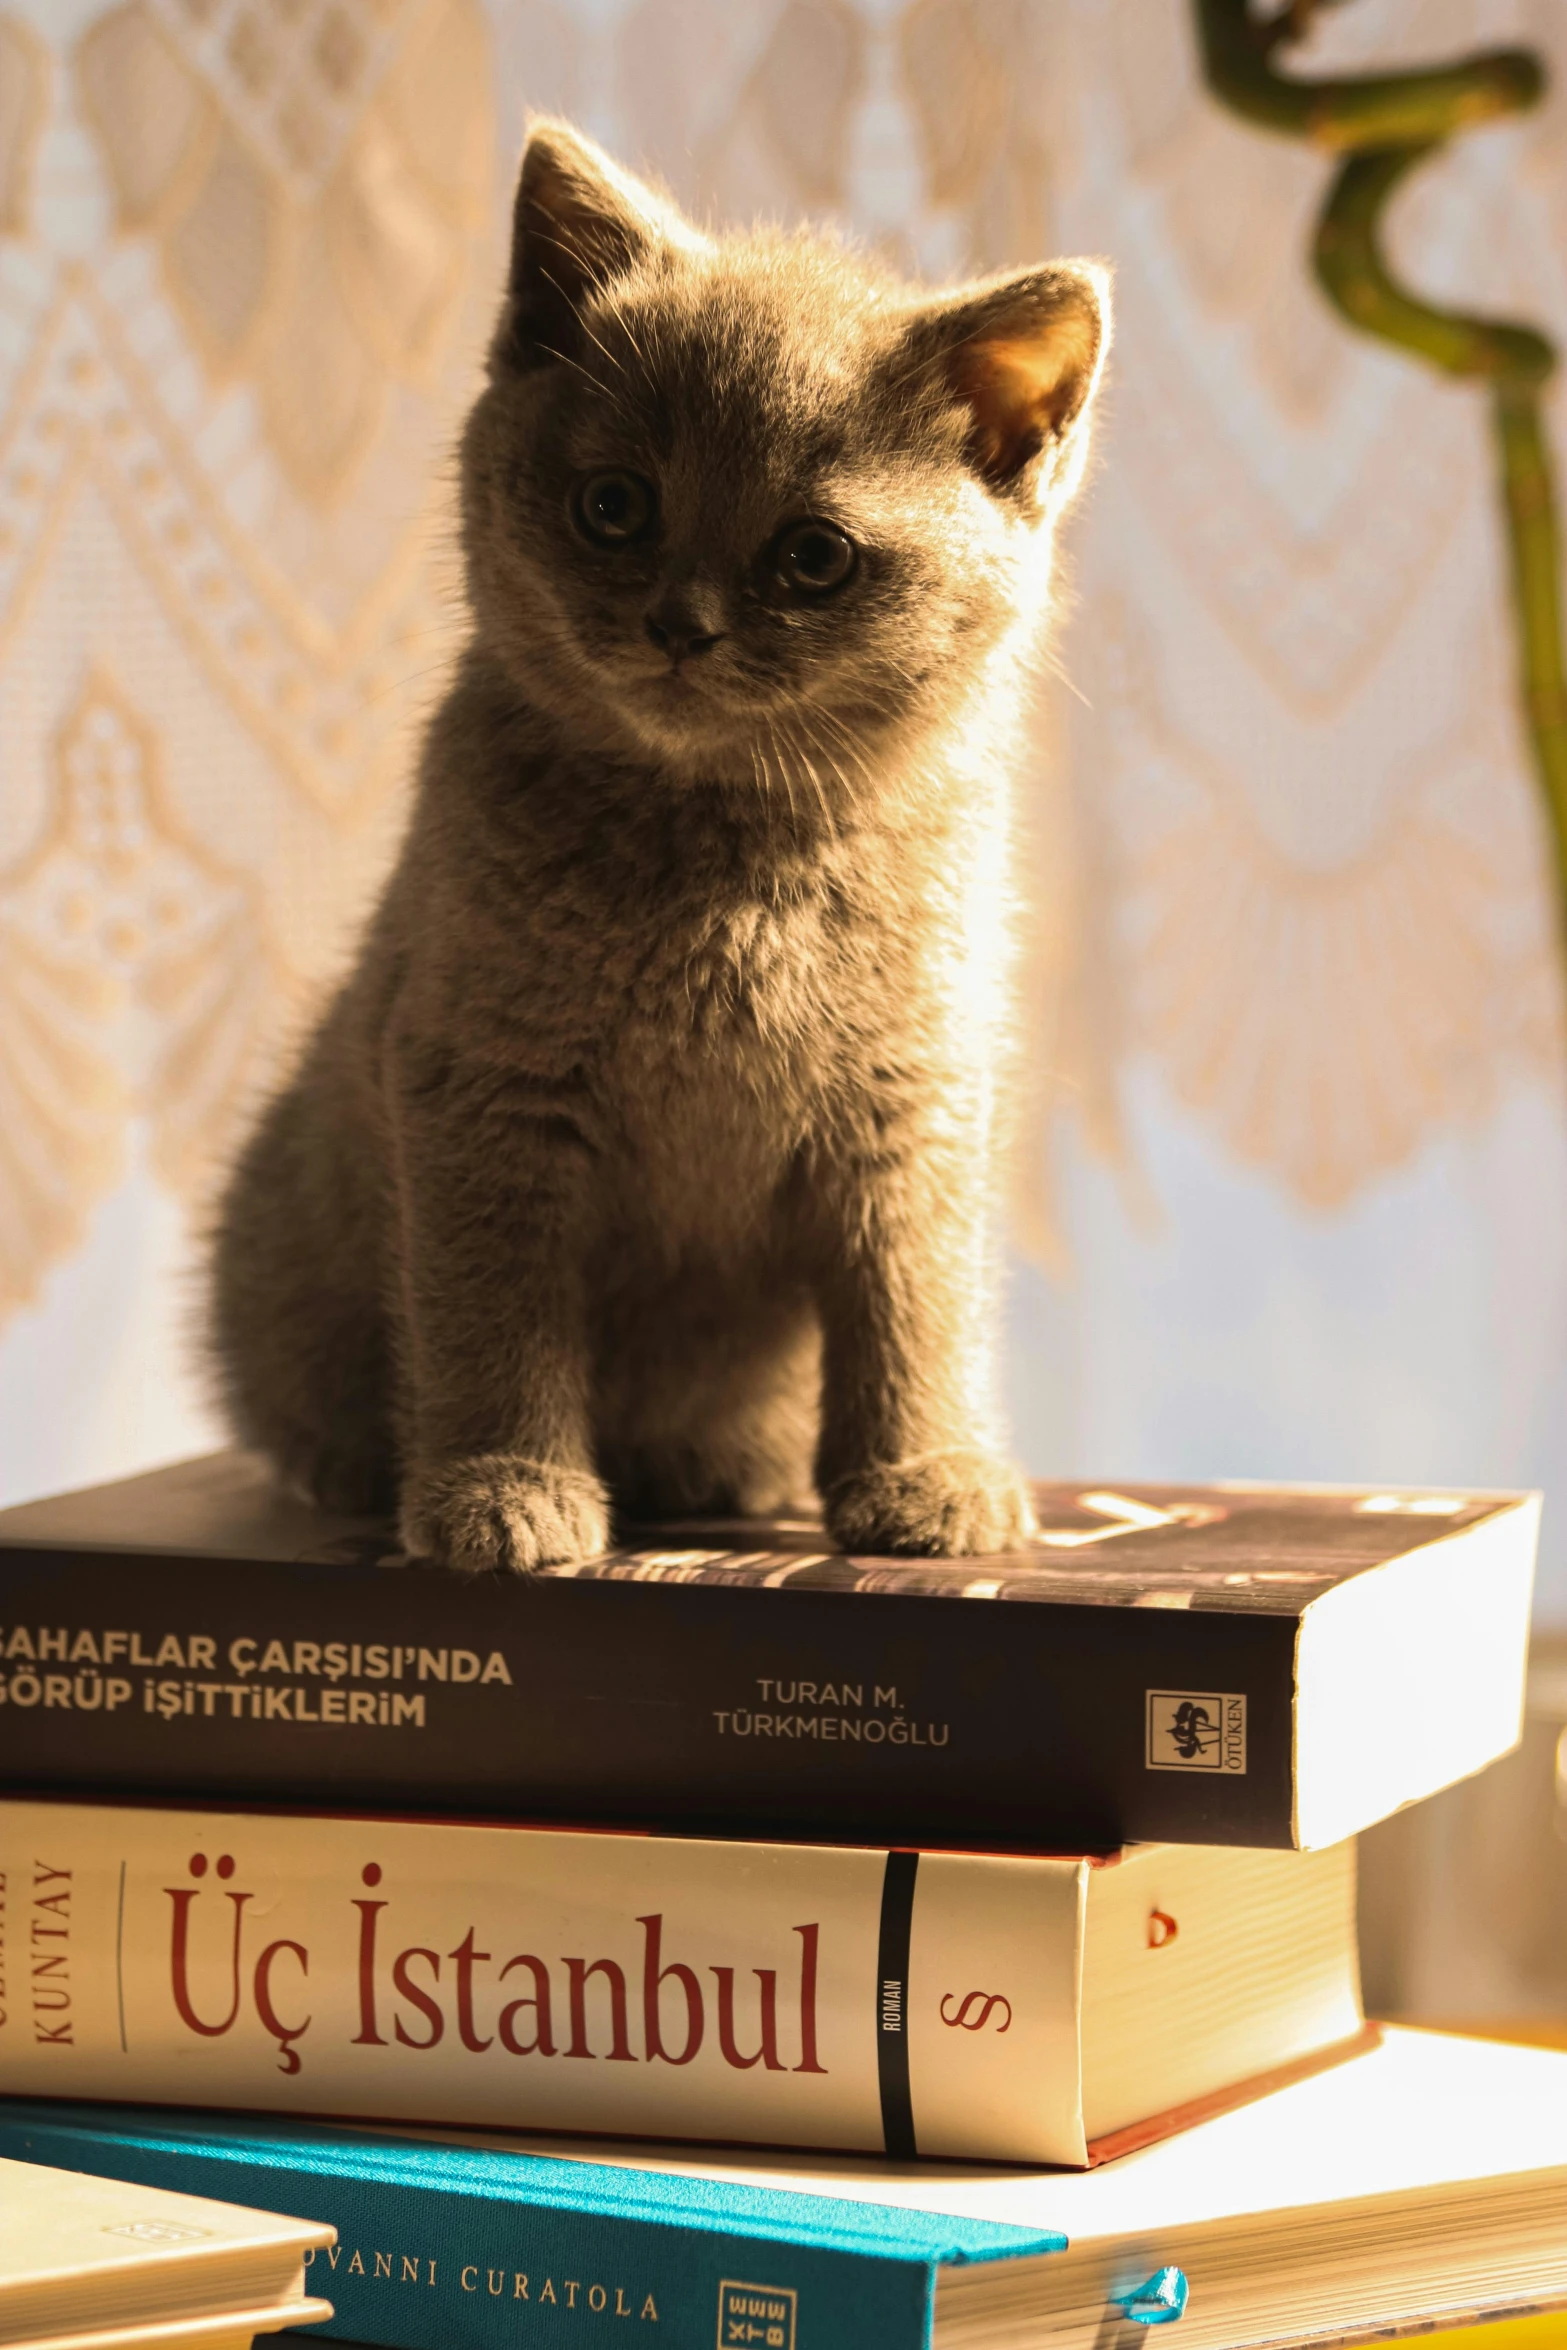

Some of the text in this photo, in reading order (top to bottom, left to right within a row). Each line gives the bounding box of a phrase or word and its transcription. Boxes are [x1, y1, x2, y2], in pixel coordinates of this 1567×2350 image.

[0, 1625, 217, 1670] AHAFLAR
[0, 1664, 133, 1711] ÖRÜP
[756, 1679, 905, 1709] TURAN M.
[713, 1708, 949, 1746] TÜRKMENOĞLU
[1224, 1698, 1243, 1770] ÖTÜKEN
[31, 1859, 75, 2047] KUNTAY
[162, 1852, 313, 2075] Üç
[350, 1862, 829, 2074] İstanbul
[883, 1980, 902, 2031] ROMAN
[460, 2265, 659, 2322] CURATOLA
